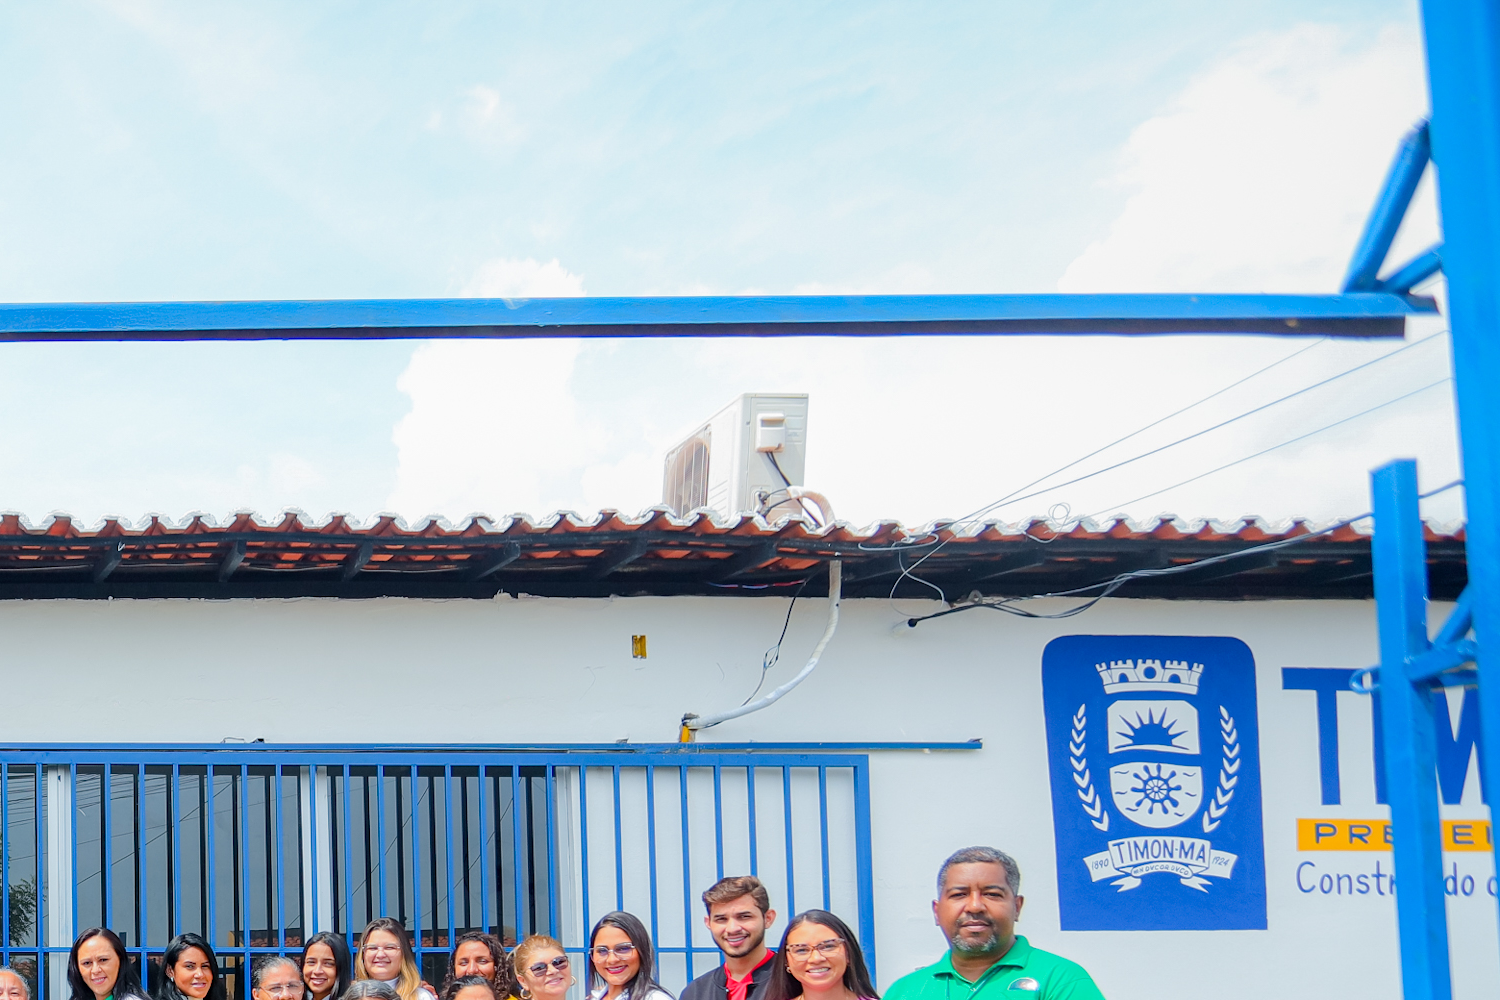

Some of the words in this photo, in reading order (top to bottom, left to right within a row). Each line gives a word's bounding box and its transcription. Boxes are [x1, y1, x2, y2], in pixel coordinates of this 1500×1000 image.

[1112, 839, 1206, 864] TIMON-MA
[1091, 858, 1109, 870] 1890
[1211, 856, 1230, 867] 1924
